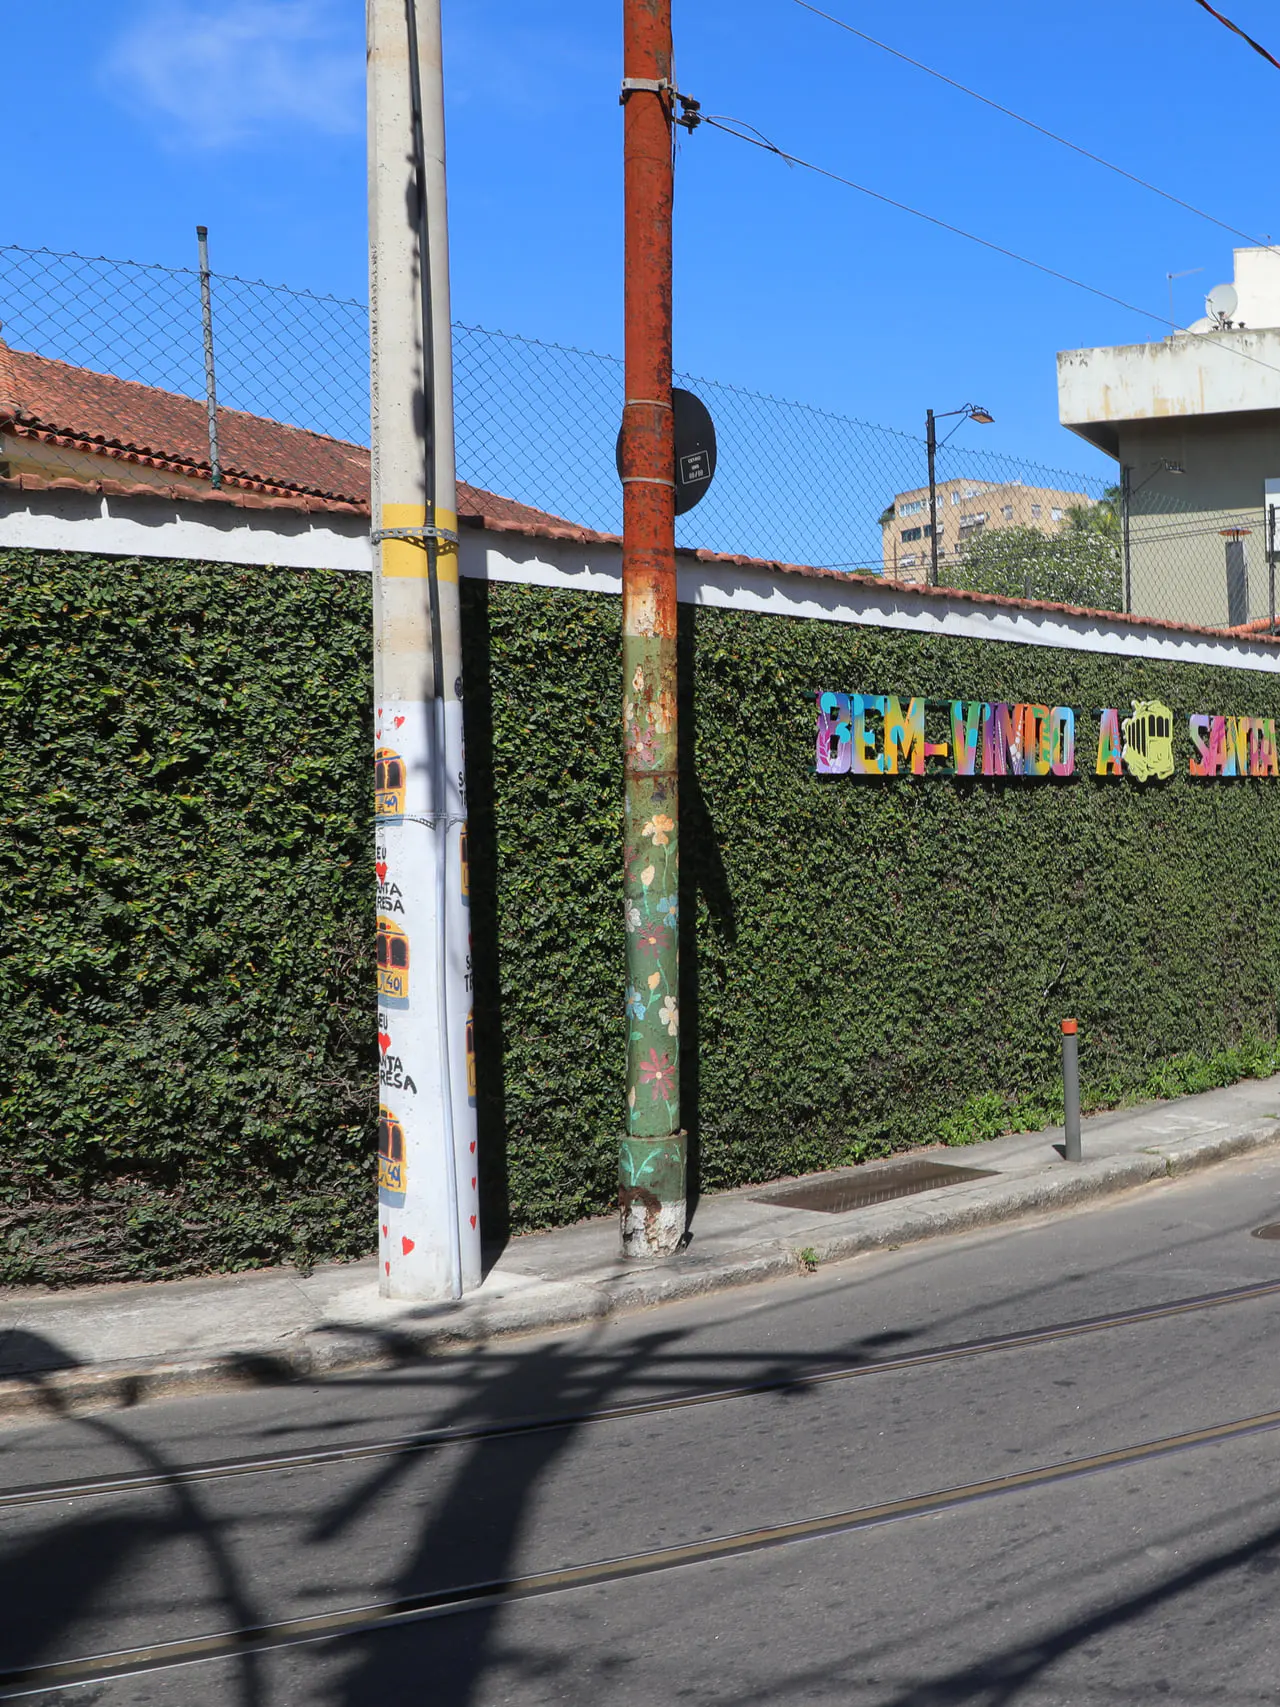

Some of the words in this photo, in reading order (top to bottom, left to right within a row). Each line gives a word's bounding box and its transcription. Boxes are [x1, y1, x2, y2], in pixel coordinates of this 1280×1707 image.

[815, 691, 1075, 776] BEM-VINDO
[1096, 708, 1123, 775] A
[1189, 714, 1280, 777] SANTA
[376, 846, 387, 860] EU
[377, 1012, 388, 1031] EU
